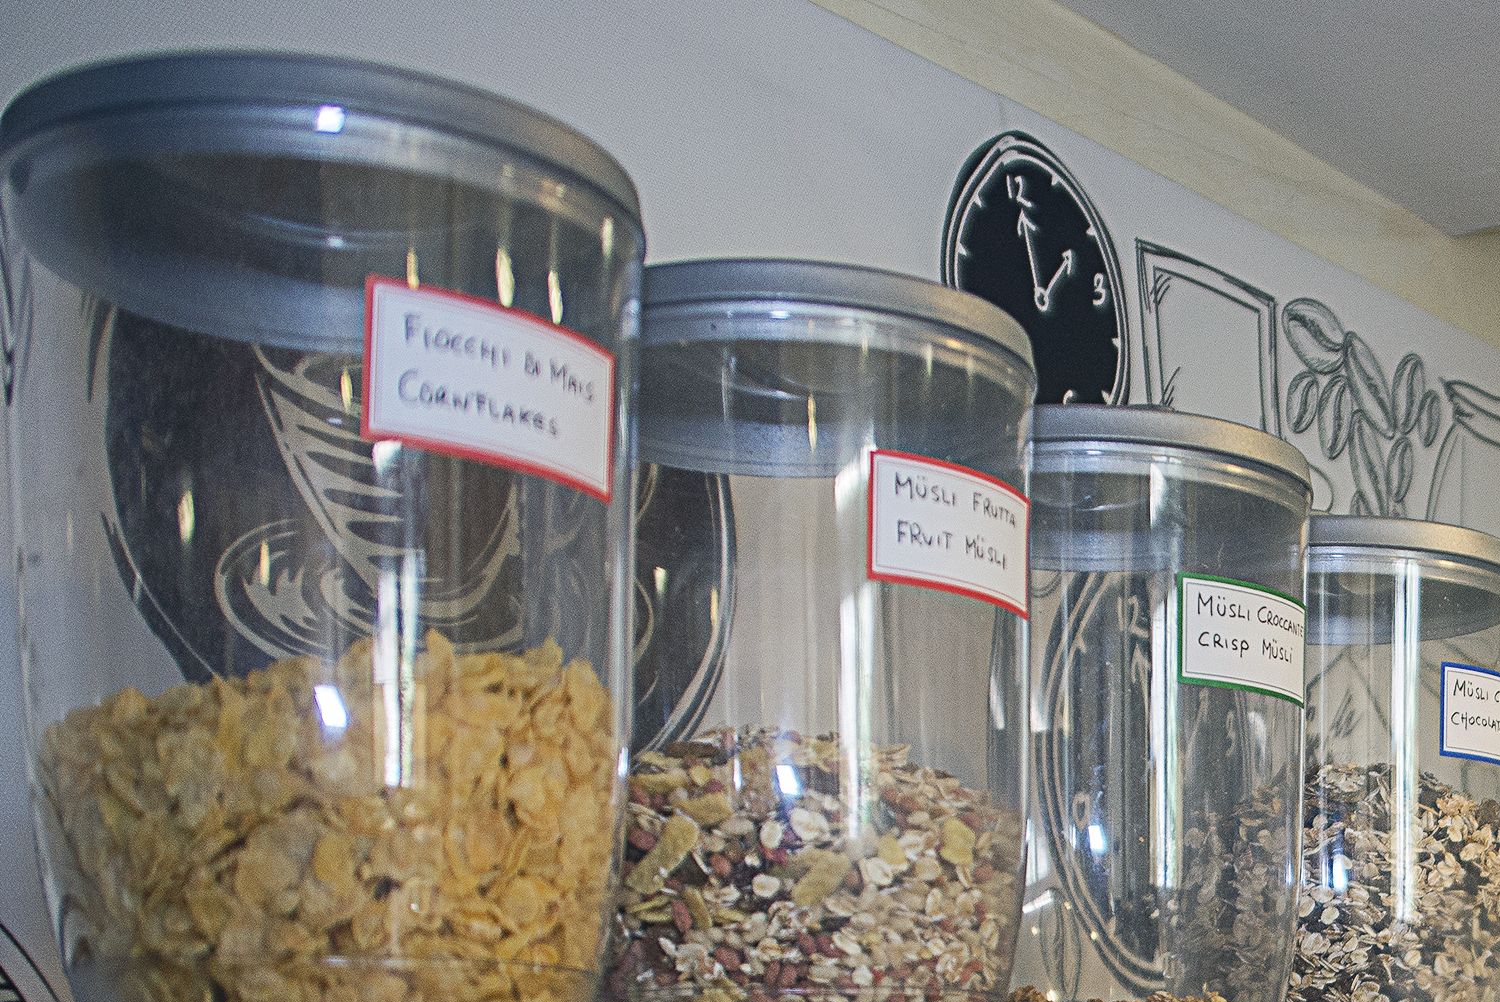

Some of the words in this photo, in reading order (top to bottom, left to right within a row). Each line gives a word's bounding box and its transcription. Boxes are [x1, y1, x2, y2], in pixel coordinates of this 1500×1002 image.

[894, 471, 956, 507] MÜSLI
[1197, 592, 1250, 621] MÜSLI
[1453, 678, 1489, 701] MÜSLI
